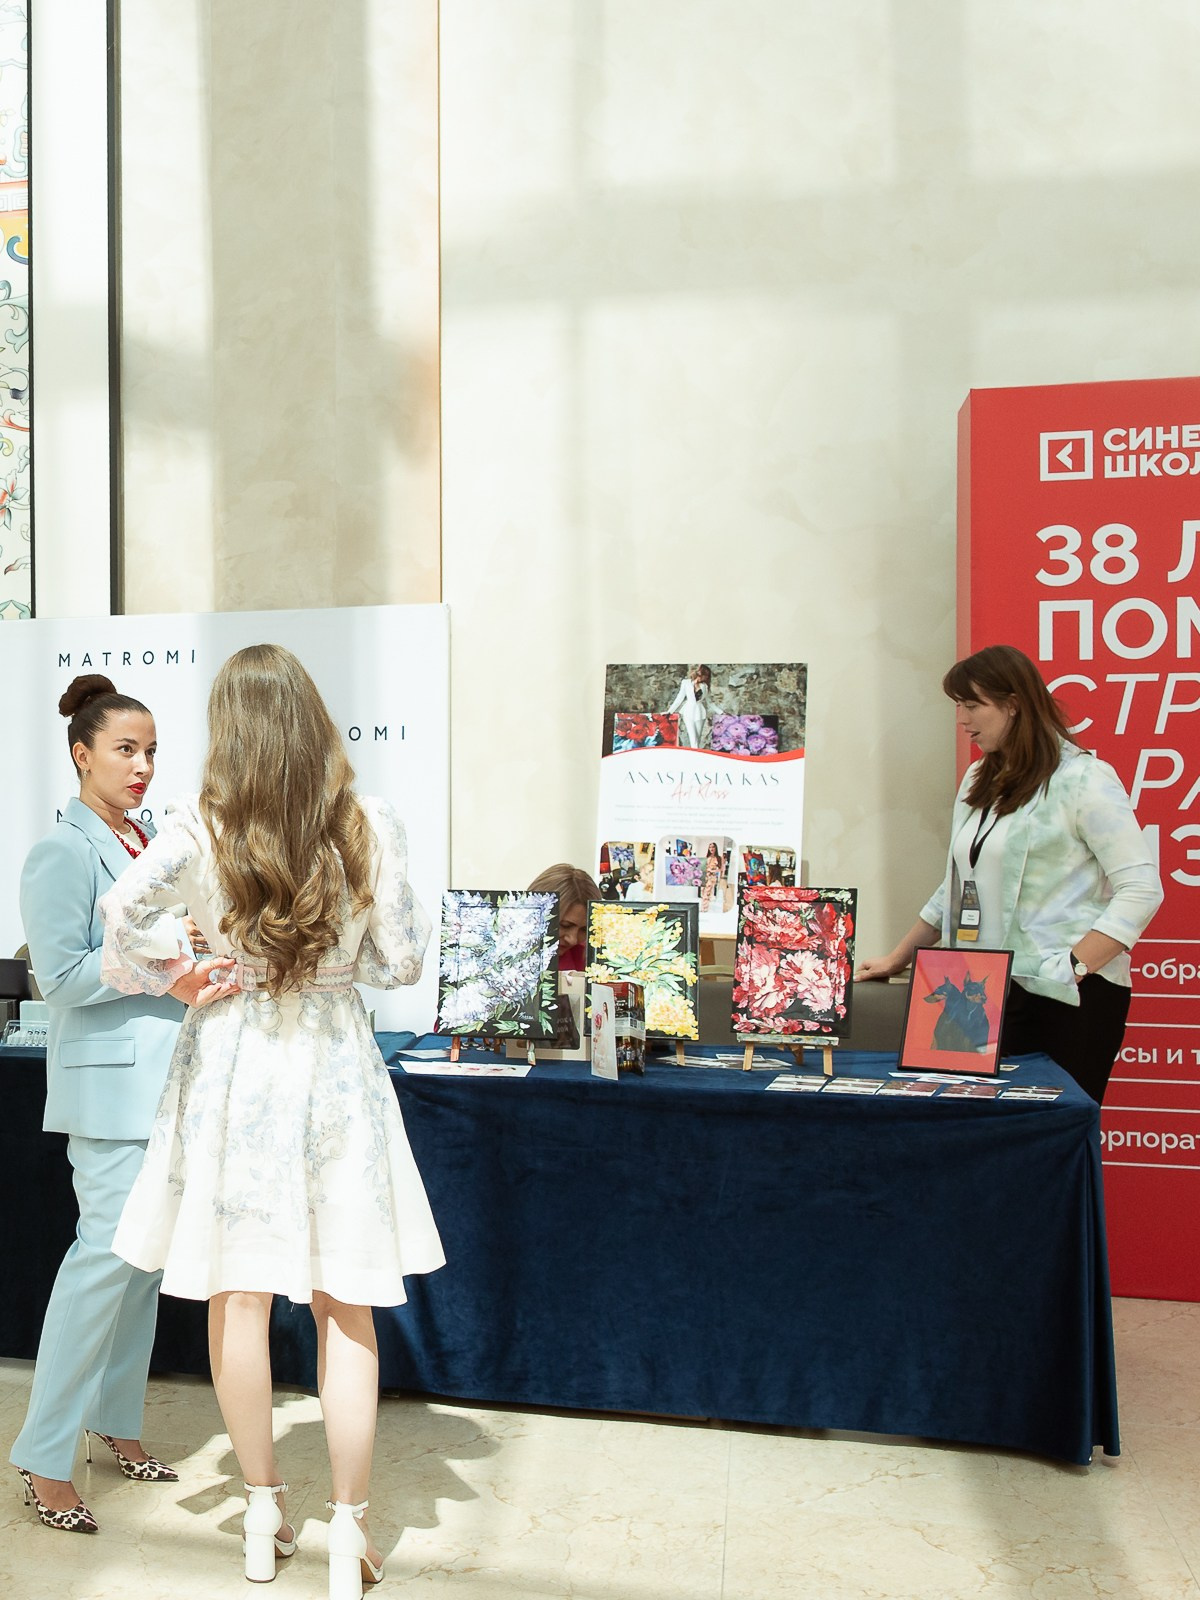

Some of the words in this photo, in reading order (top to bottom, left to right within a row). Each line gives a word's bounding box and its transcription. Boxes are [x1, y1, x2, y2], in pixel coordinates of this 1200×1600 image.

[1035, 523, 1140, 587] 38
[58, 650, 196, 668] MATROMI
[1130, 958, 1200, 985] -обр
[1114, 1046, 1158, 1065] сы
[1166, 1048, 1183, 1065] и
[1100, 1129, 1200, 1154] рпора
